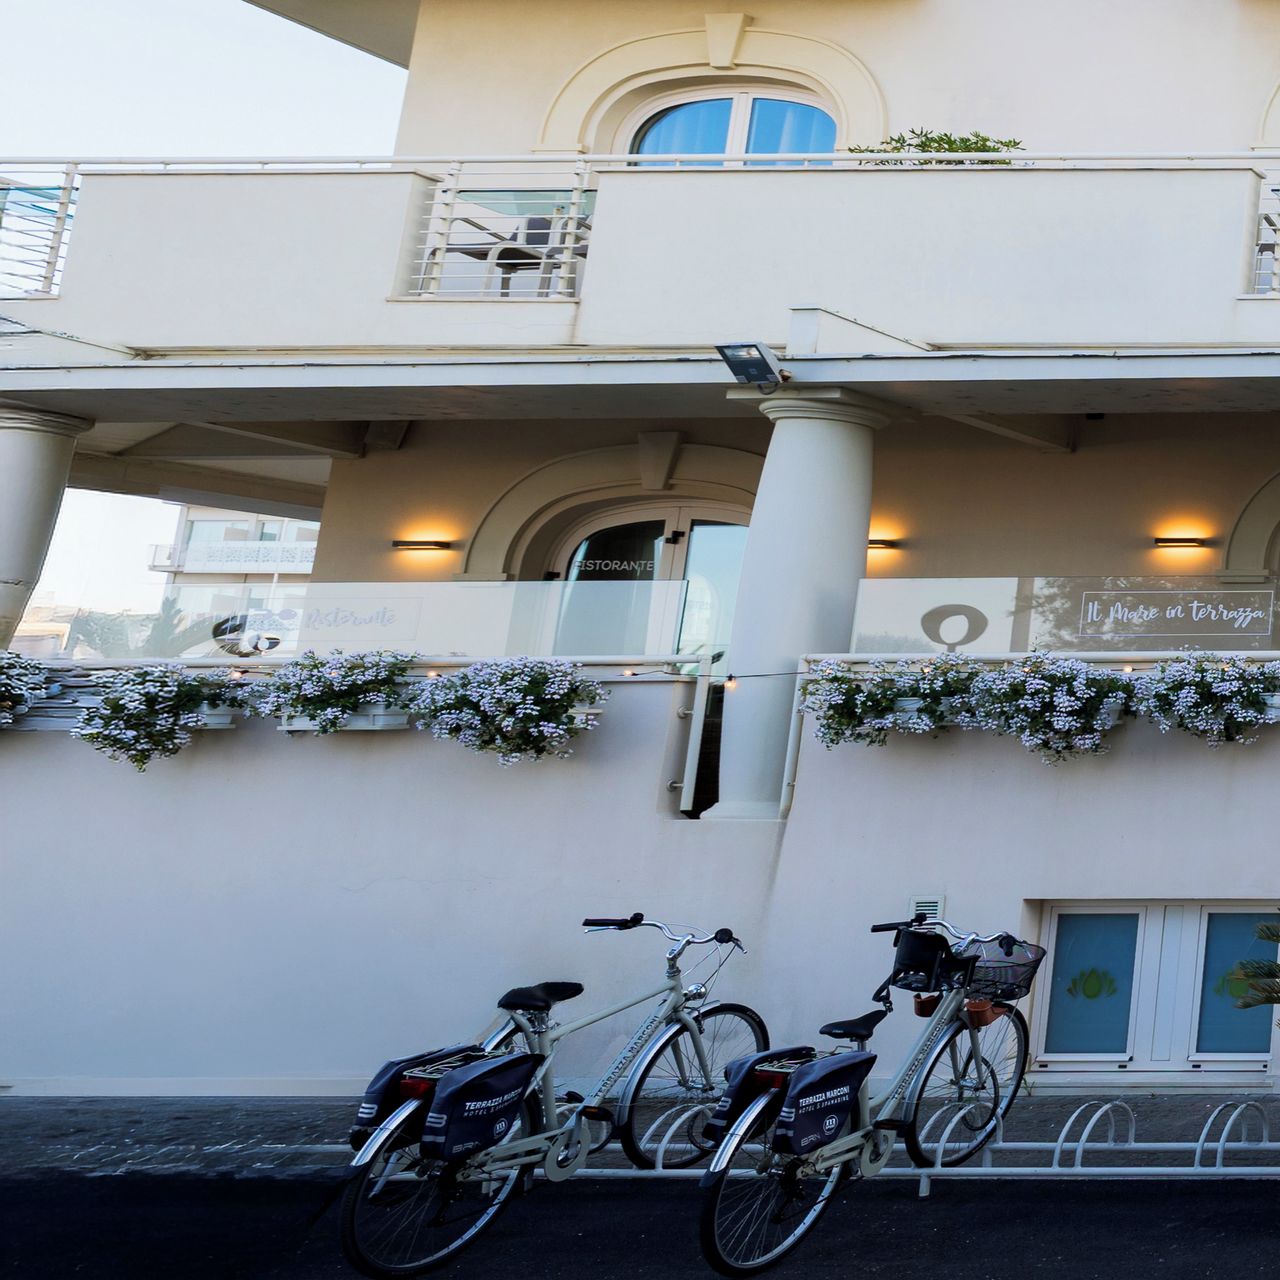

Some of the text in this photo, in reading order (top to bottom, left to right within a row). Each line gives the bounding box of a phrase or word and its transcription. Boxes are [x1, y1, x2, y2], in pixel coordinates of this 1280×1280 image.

[1109, 601, 1159, 623] Mare
[1166, 604, 1185, 618] in
[799, 1085, 850, 1108] TERRAZZA MARCONI
